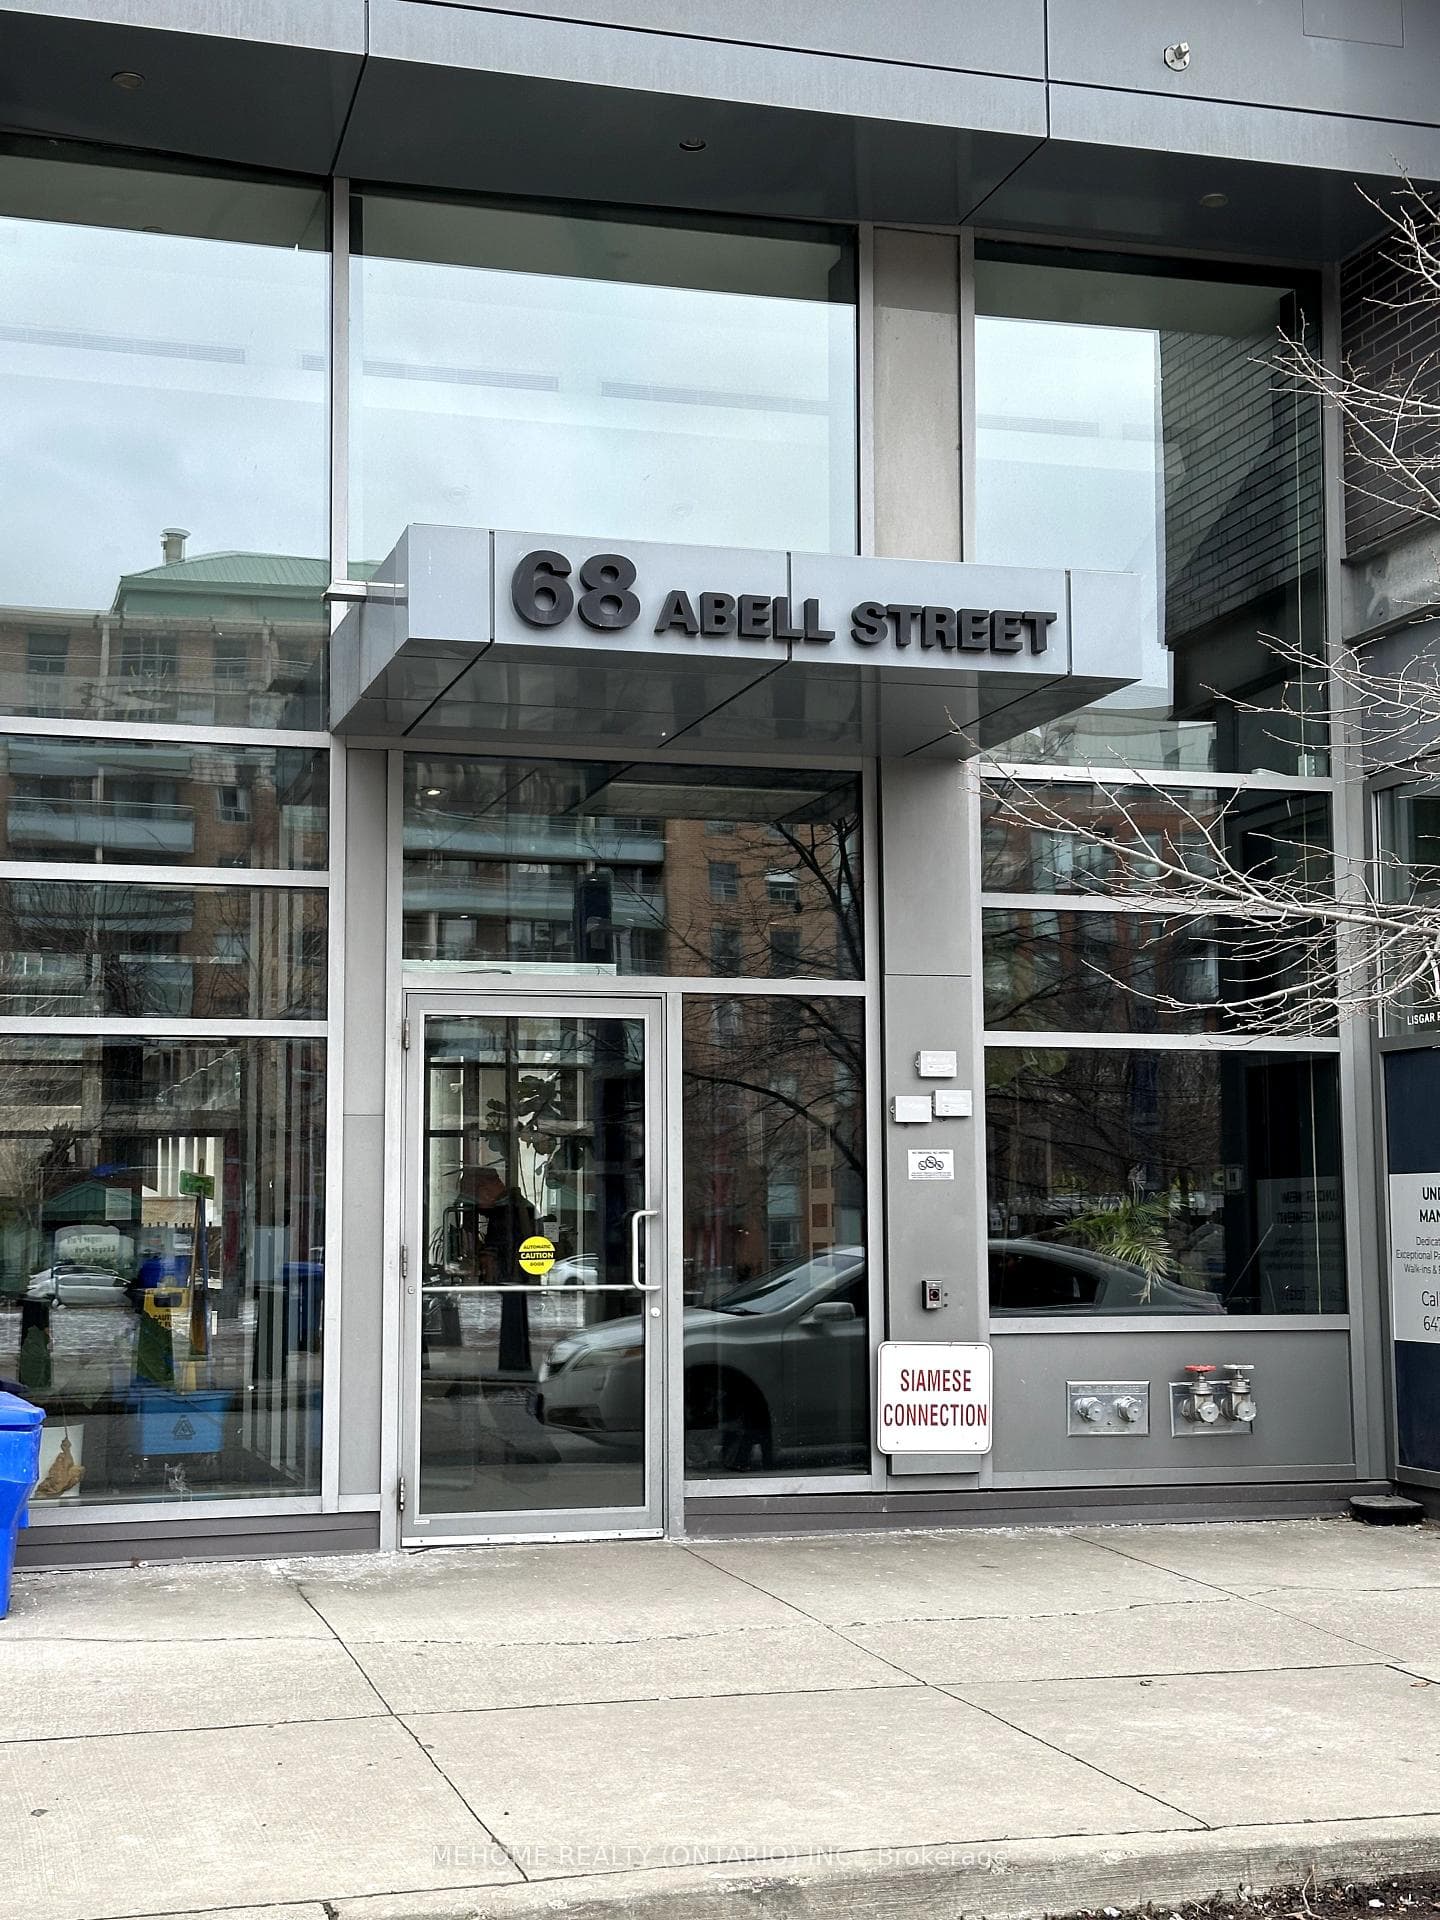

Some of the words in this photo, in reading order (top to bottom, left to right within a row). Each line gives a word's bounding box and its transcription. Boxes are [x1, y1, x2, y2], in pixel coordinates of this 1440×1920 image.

[511, 550, 641, 632] 68
[654, 590, 835, 643] ABELL
[849, 601, 1057, 654] STREET
[1407, 1012, 1435, 1026] LISGAR
[900, 1369, 972, 1392] SIAMESE
[884, 1403, 987, 1427] CONNECTION
